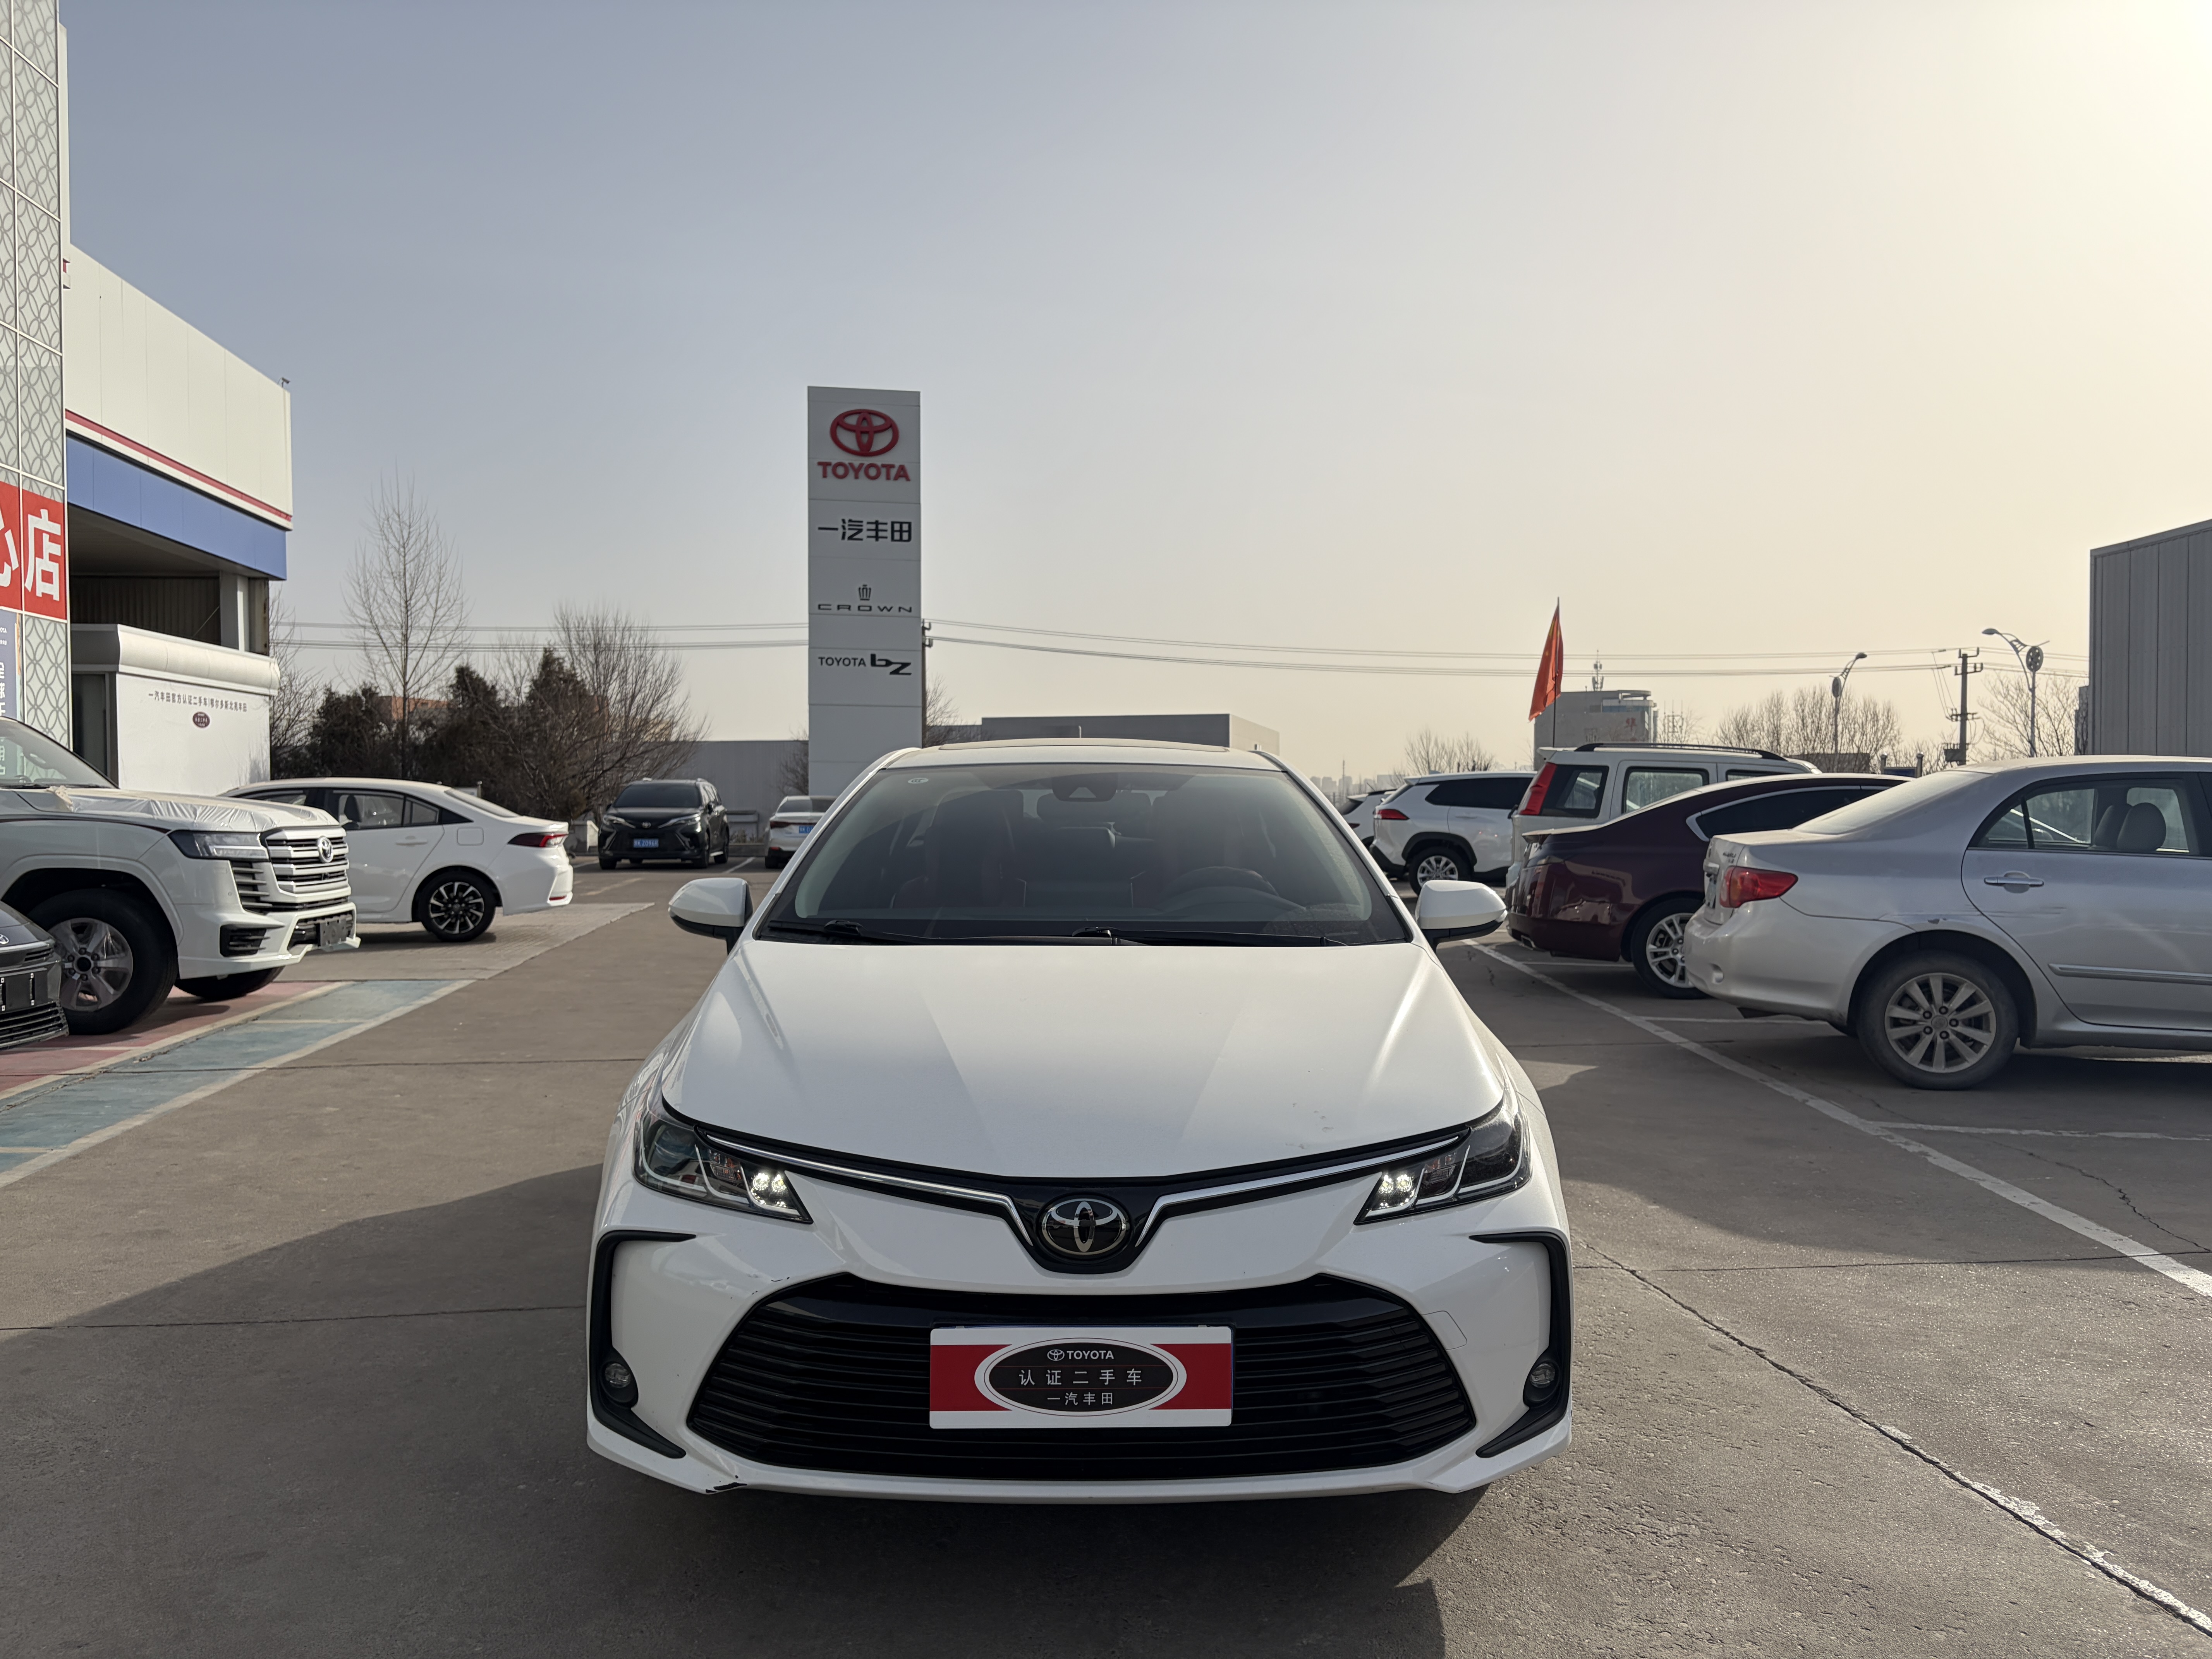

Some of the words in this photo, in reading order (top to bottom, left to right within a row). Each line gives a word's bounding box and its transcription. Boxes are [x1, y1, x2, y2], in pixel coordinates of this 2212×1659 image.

[817, 461, 911, 481] TOYOTA
[818, 519, 912, 542] 一汽丰田
[818, 604, 912, 613] CROWN
[818, 656, 867, 667] TOYOTA
[1066, 1350, 1114, 1360] TOYOTA
[1019, 1368, 1142, 1386] 认证二手车
[1047, 1392, 1113, 1406] 一汽丰田
